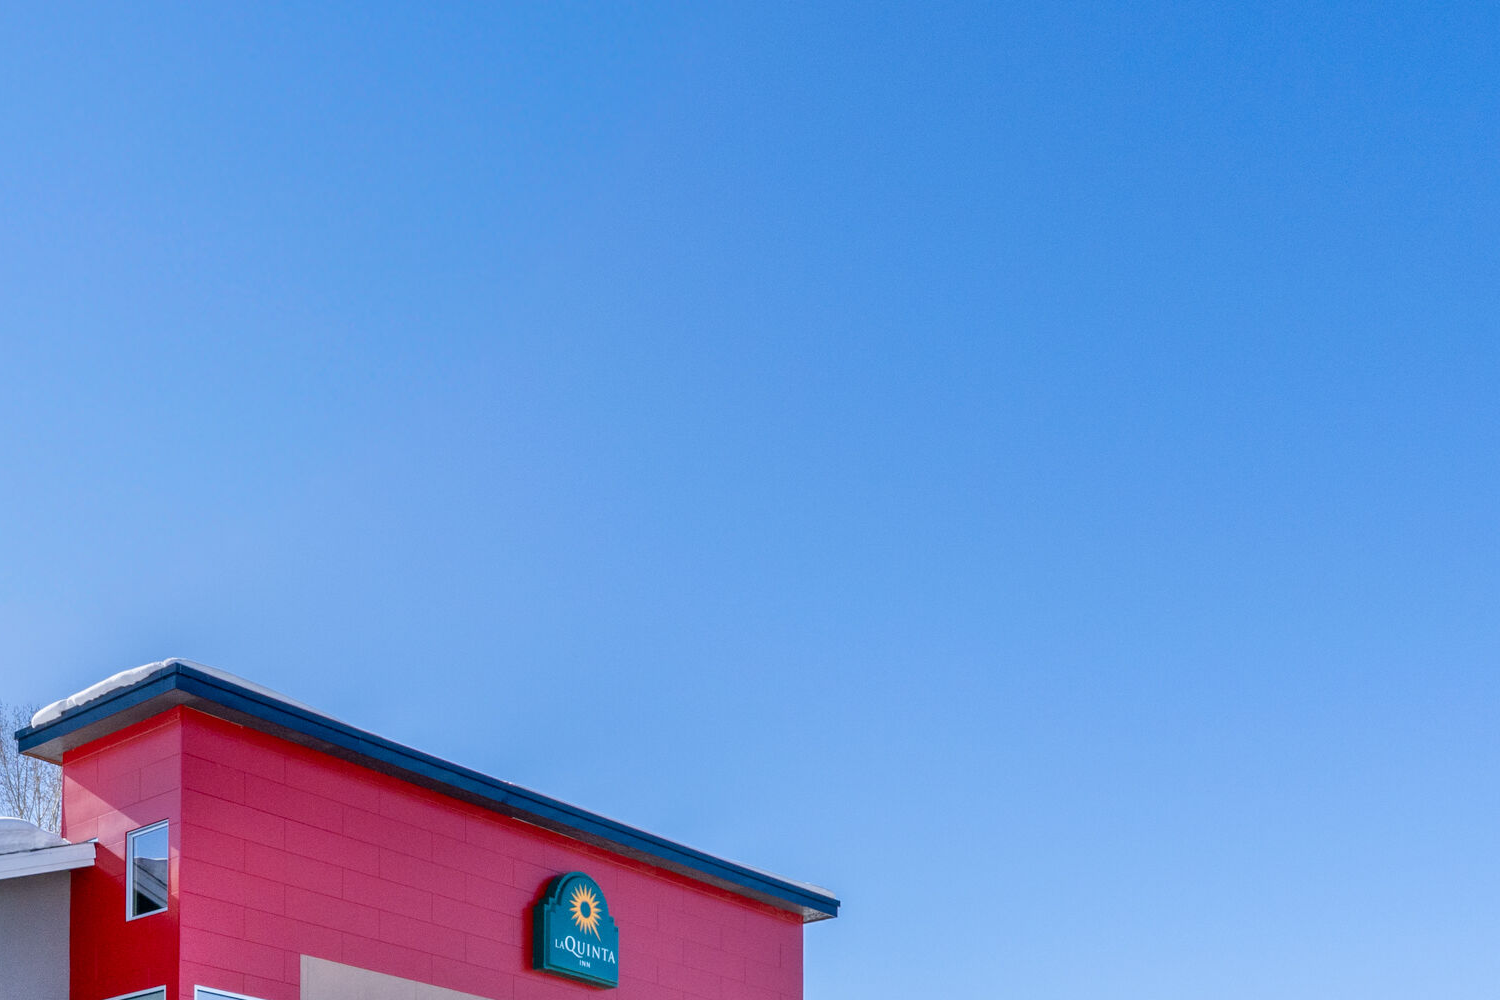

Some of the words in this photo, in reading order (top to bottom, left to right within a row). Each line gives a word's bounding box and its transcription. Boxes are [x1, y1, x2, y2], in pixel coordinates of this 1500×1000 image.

[555, 938, 565, 949] LA
[565, 935, 616, 964] QUINTA
[579, 959, 591, 968] INN
